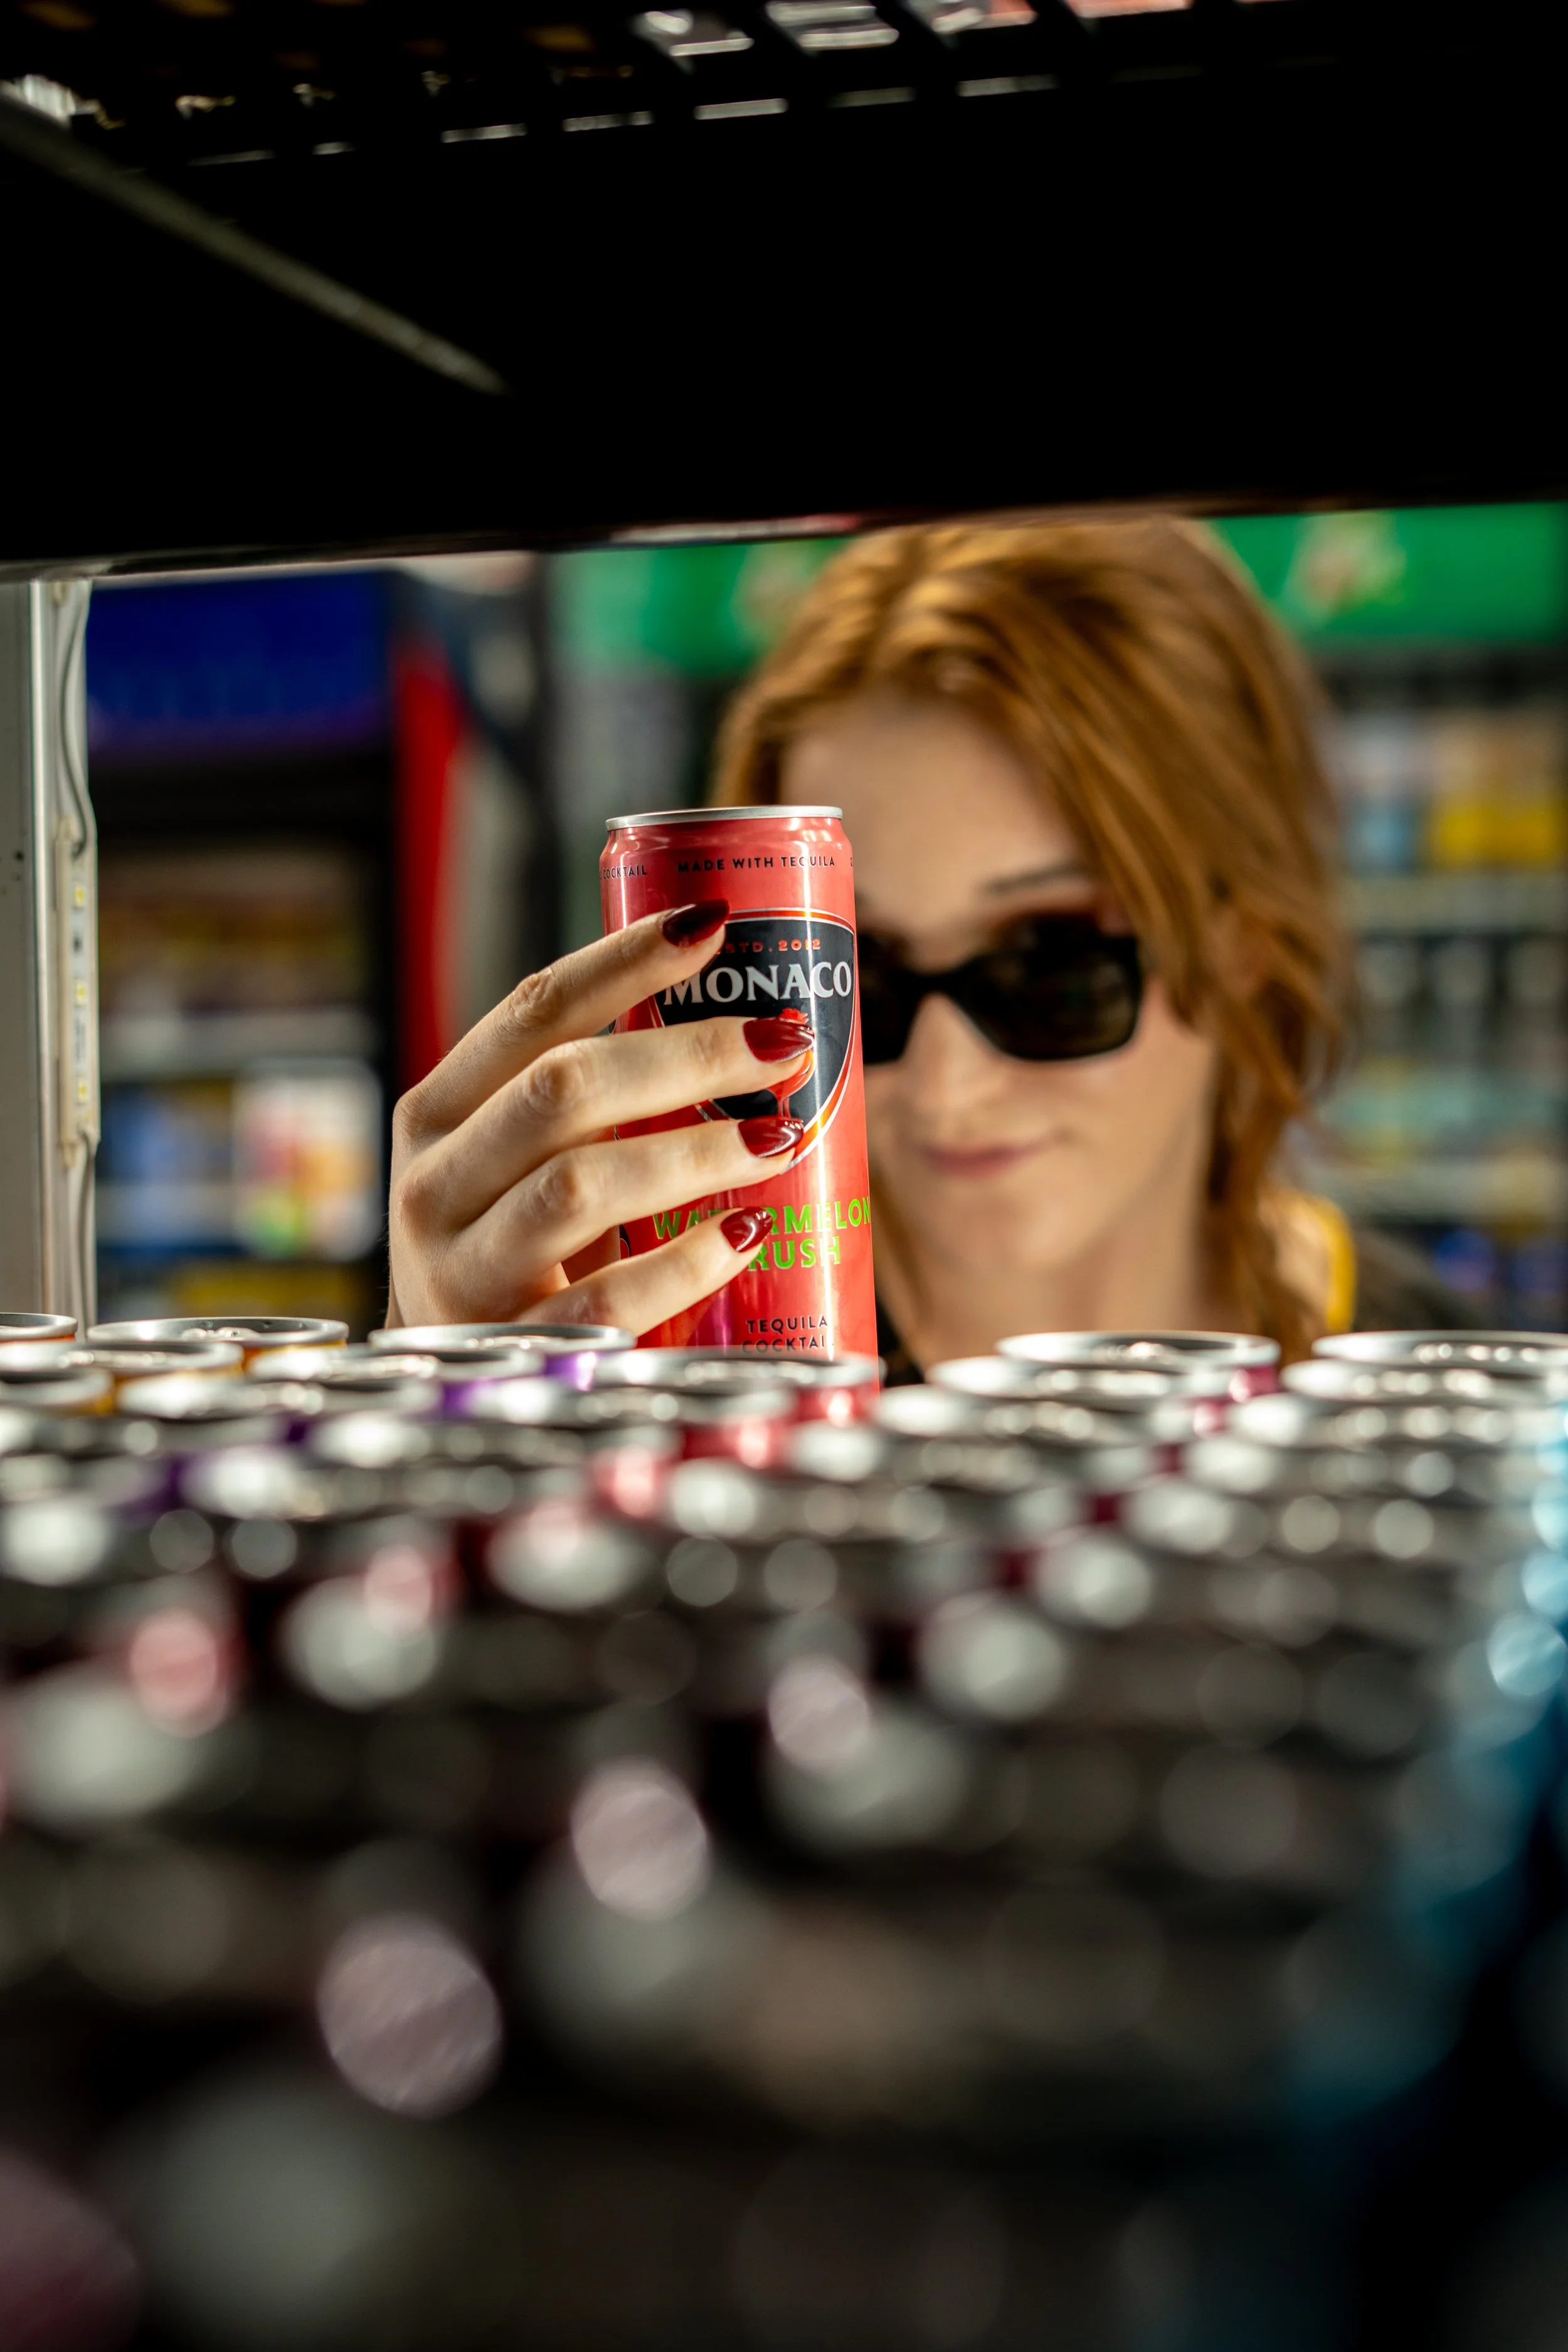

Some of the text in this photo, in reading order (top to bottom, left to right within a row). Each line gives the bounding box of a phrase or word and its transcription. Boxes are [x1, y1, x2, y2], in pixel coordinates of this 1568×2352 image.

[603, 864, 647, 879] COCKTAIL
[677, 859, 725, 872] MADE
[733, 857, 773, 869] WITH
[664, 961, 852, 1005] MONACO
[748, 1236, 840, 1271] RUSH
[746, 1314, 828, 1335] TEQUILA
[741, 1335, 834, 1355] COCKTAI
